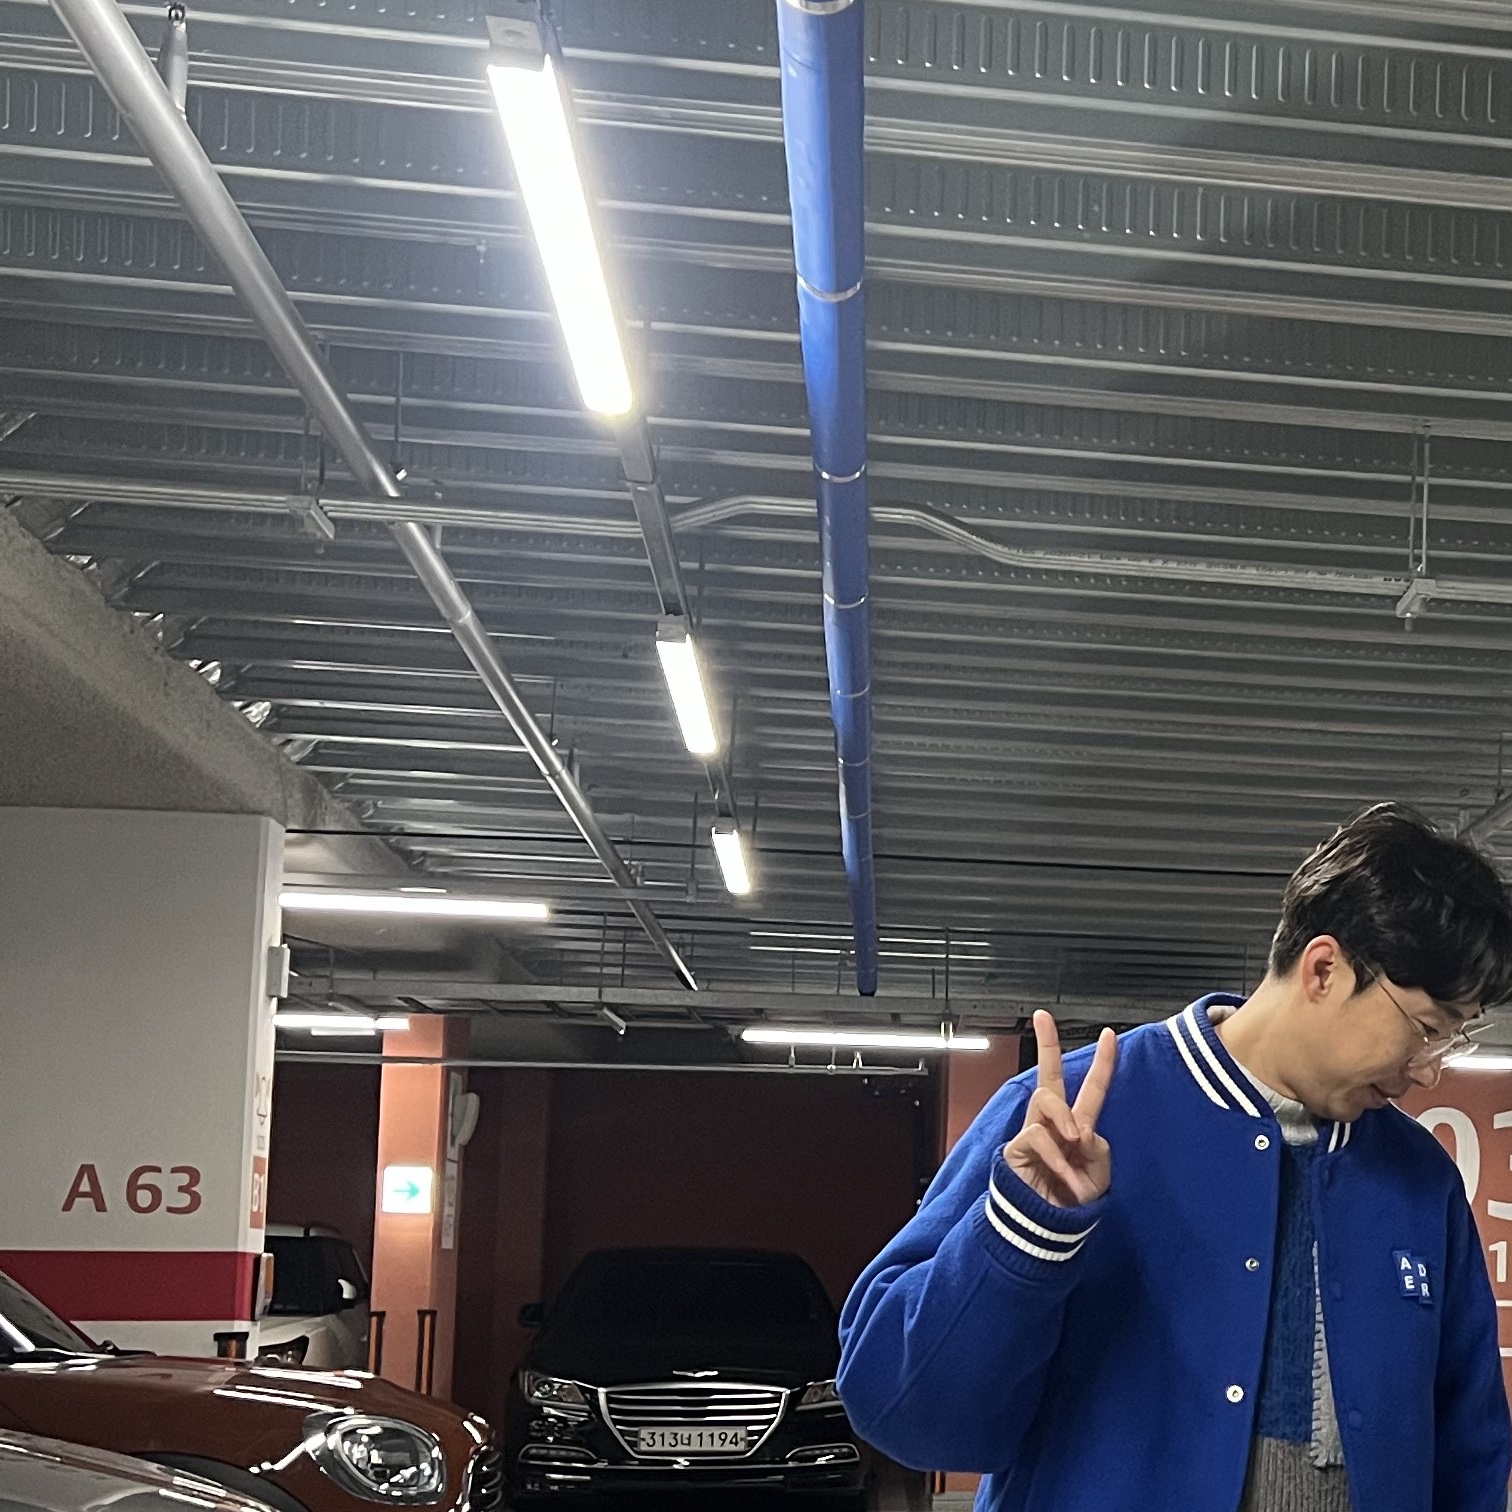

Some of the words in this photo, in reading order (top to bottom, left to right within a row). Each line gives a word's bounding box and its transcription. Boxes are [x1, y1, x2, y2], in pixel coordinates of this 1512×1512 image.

[61, 1163, 108, 1213] A
[126, 1164, 203, 1215] 63
[646, 1431, 692, 1448] 313너
[697, 1431, 740, 1448] 1194
